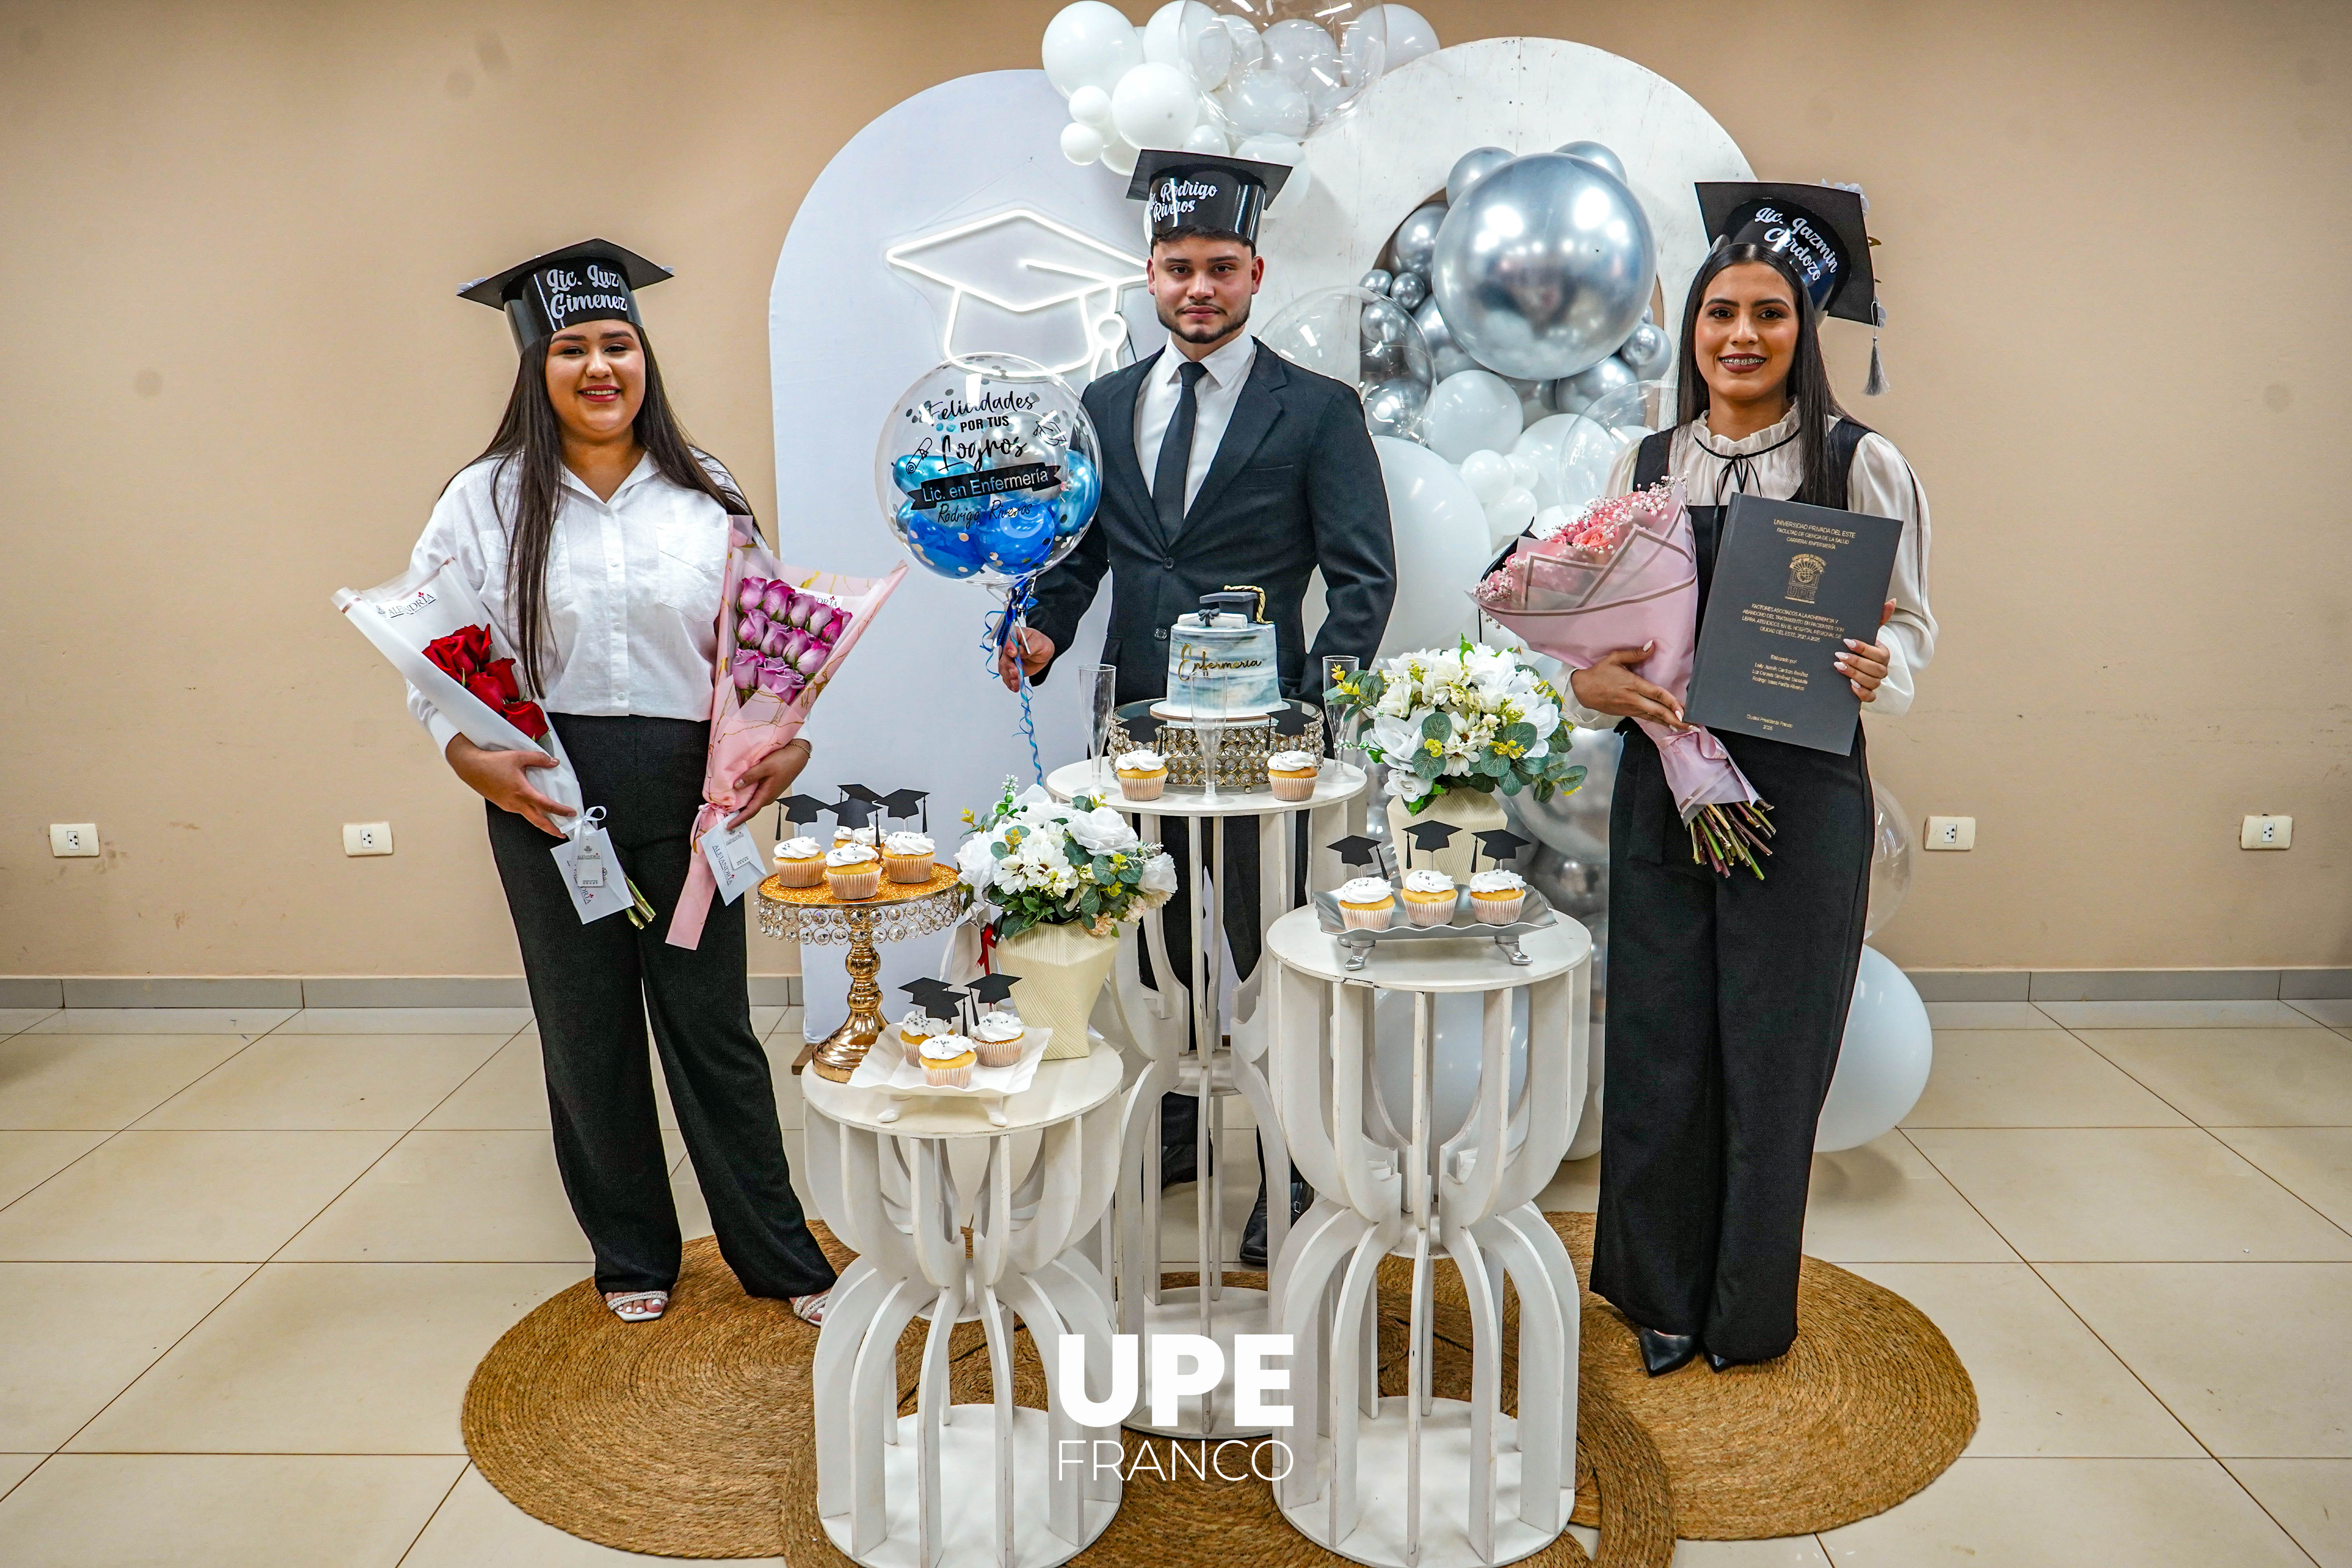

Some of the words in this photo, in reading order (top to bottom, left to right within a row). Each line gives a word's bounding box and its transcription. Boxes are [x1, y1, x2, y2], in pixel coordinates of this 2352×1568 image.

[1160, 180, 1218, 202] Rodrigo
[1153, 200, 1196, 223] Riveros
[1754, 207, 1784, 224] Lic.
[1764, 228, 1821, 281] Crdozo
[546, 269, 582, 294] Lic.
[587, 265, 619, 289] Luz
[550, 293, 627, 319] Gimenez
[960, 419, 984, 433] POR
[987, 416, 1009, 428] TUS
[938, 435, 1027, 472] Logros
[922, 487, 946, 503] Lic.
[949, 485, 967, 497] en
[970, 470, 1049, 495] Enfermería
[937, 503, 980, 529] Rodrigo
[989, 499, 1033, 521] Riveros
[1773, 519, 1808, 530] UNIVERSIDAD
[1808, 525, 1830, 533] PRIVADA
[1777, 527, 1798, 535] FACULTAD
[1787, 586, 1816, 600] UPE
[1742, 609, 1766, 617] ABANDONO
[1810, 621, 1834, 630] PACIENTES
[1751, 604, 1773, 612] FACTORES
[1773, 608, 1798, 616] ASOCIADOS
[1756, 619, 1780, 627] ATENDIDOS
[1793, 626, 1813, 634] HOSPITAL
